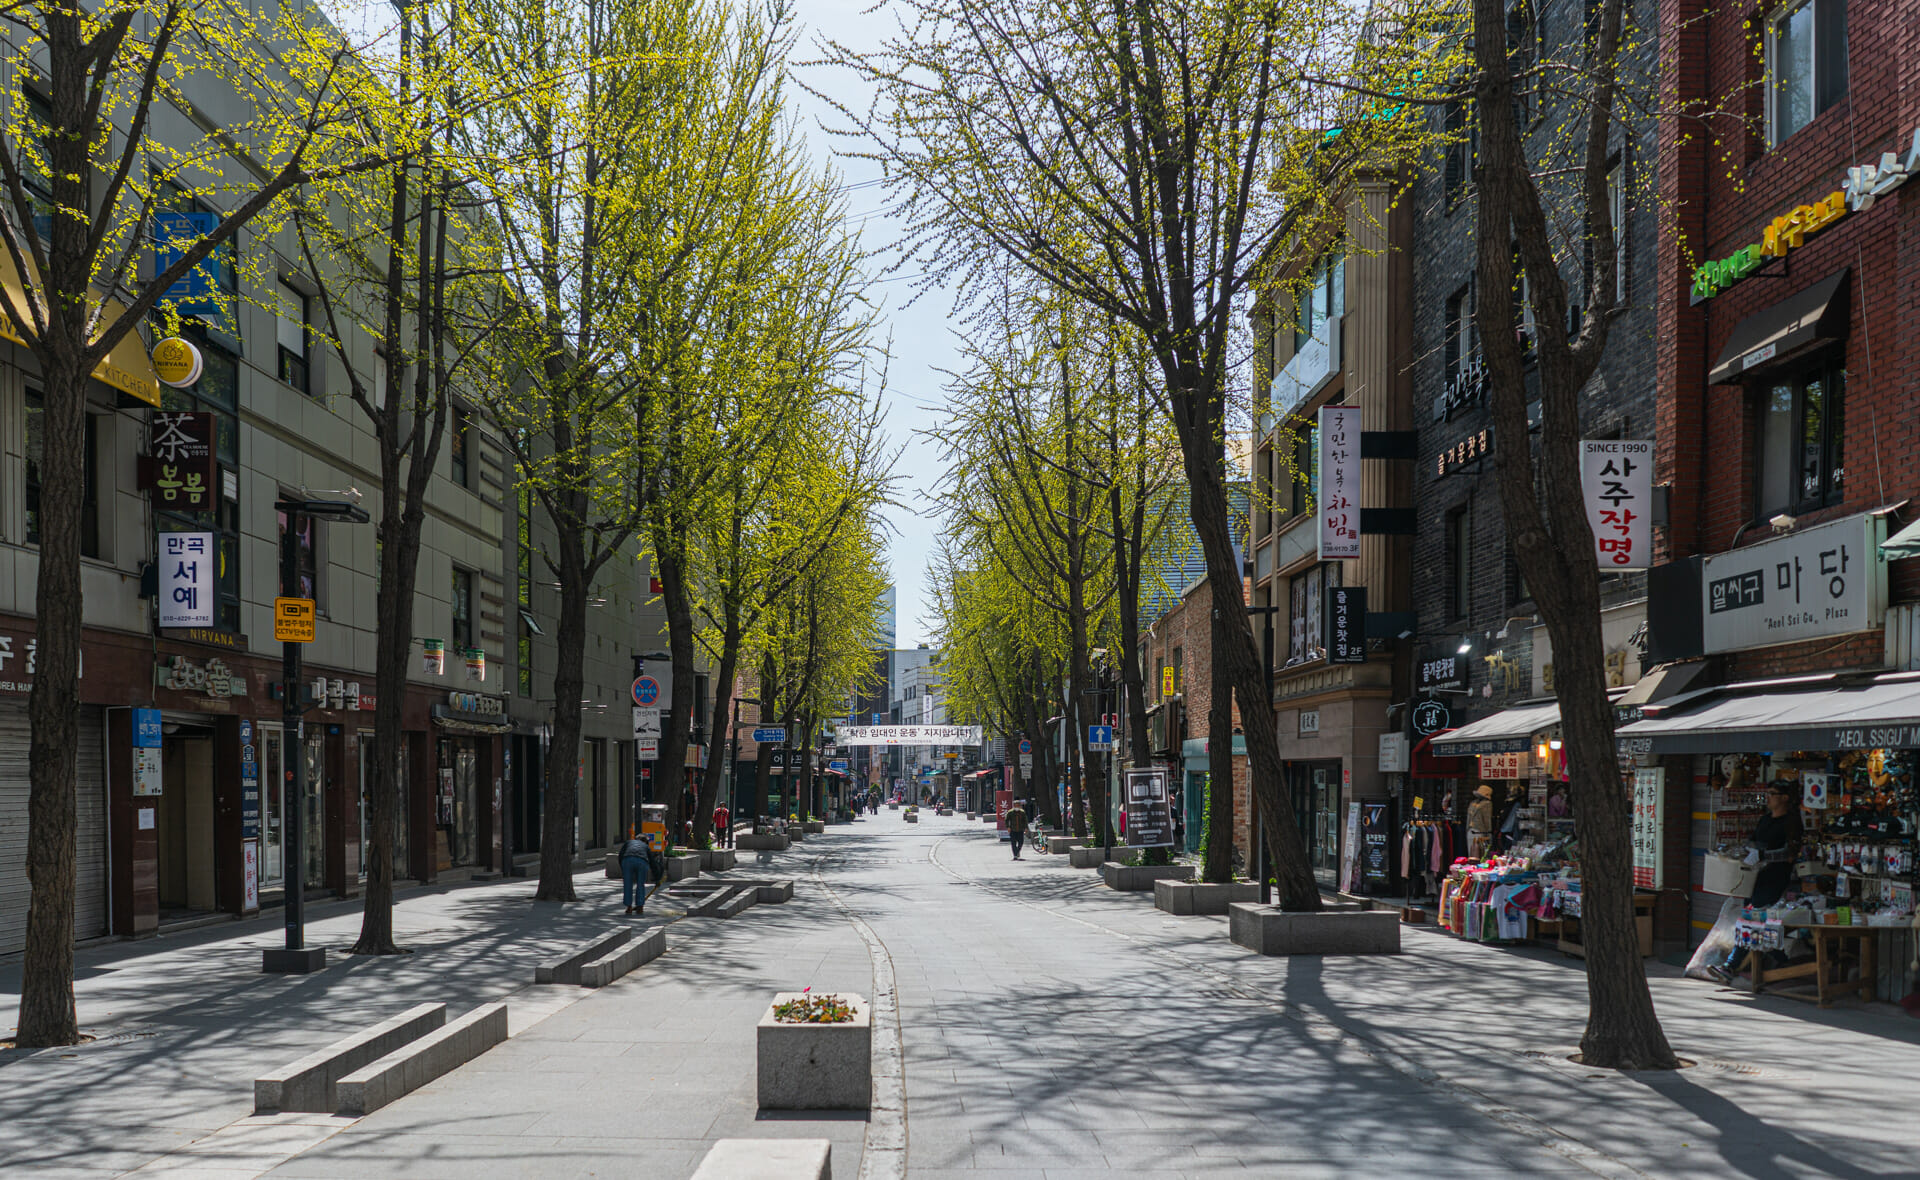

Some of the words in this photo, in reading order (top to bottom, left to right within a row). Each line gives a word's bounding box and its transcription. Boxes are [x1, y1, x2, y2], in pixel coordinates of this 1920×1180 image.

[103, 365, 152, 398] KITCHEN
[153, 412, 200, 463] 茶
[1587, 443, 1618, 453] SINCE
[1621, 443, 1648, 453] 1990
[1598, 456, 1638, 507] 사주
[1326, 494, 1352, 537] 차빔
[1598, 508, 1638, 565] 작명
[167, 537, 204, 555] 만곡
[173, 561, 197, 609] 서예
[1712, 574, 1760, 610] 얼씨구
[1776, 544, 1849, 604] 마당
[1825, 607, 1848, 620] Plaza
[190, 629, 234, 647] NIRVANA
[1350, 646, 1363, 655] 2F
[870, 728, 897, 738] 임대인
[924, 728, 972, 739] 지지합니다!
[1483, 768, 1517, 778] 그림매매
[1634, 802, 1656, 819] 작명
[1634, 822, 1656, 835] 타로
[1634, 838, 1656, 854] 택일
